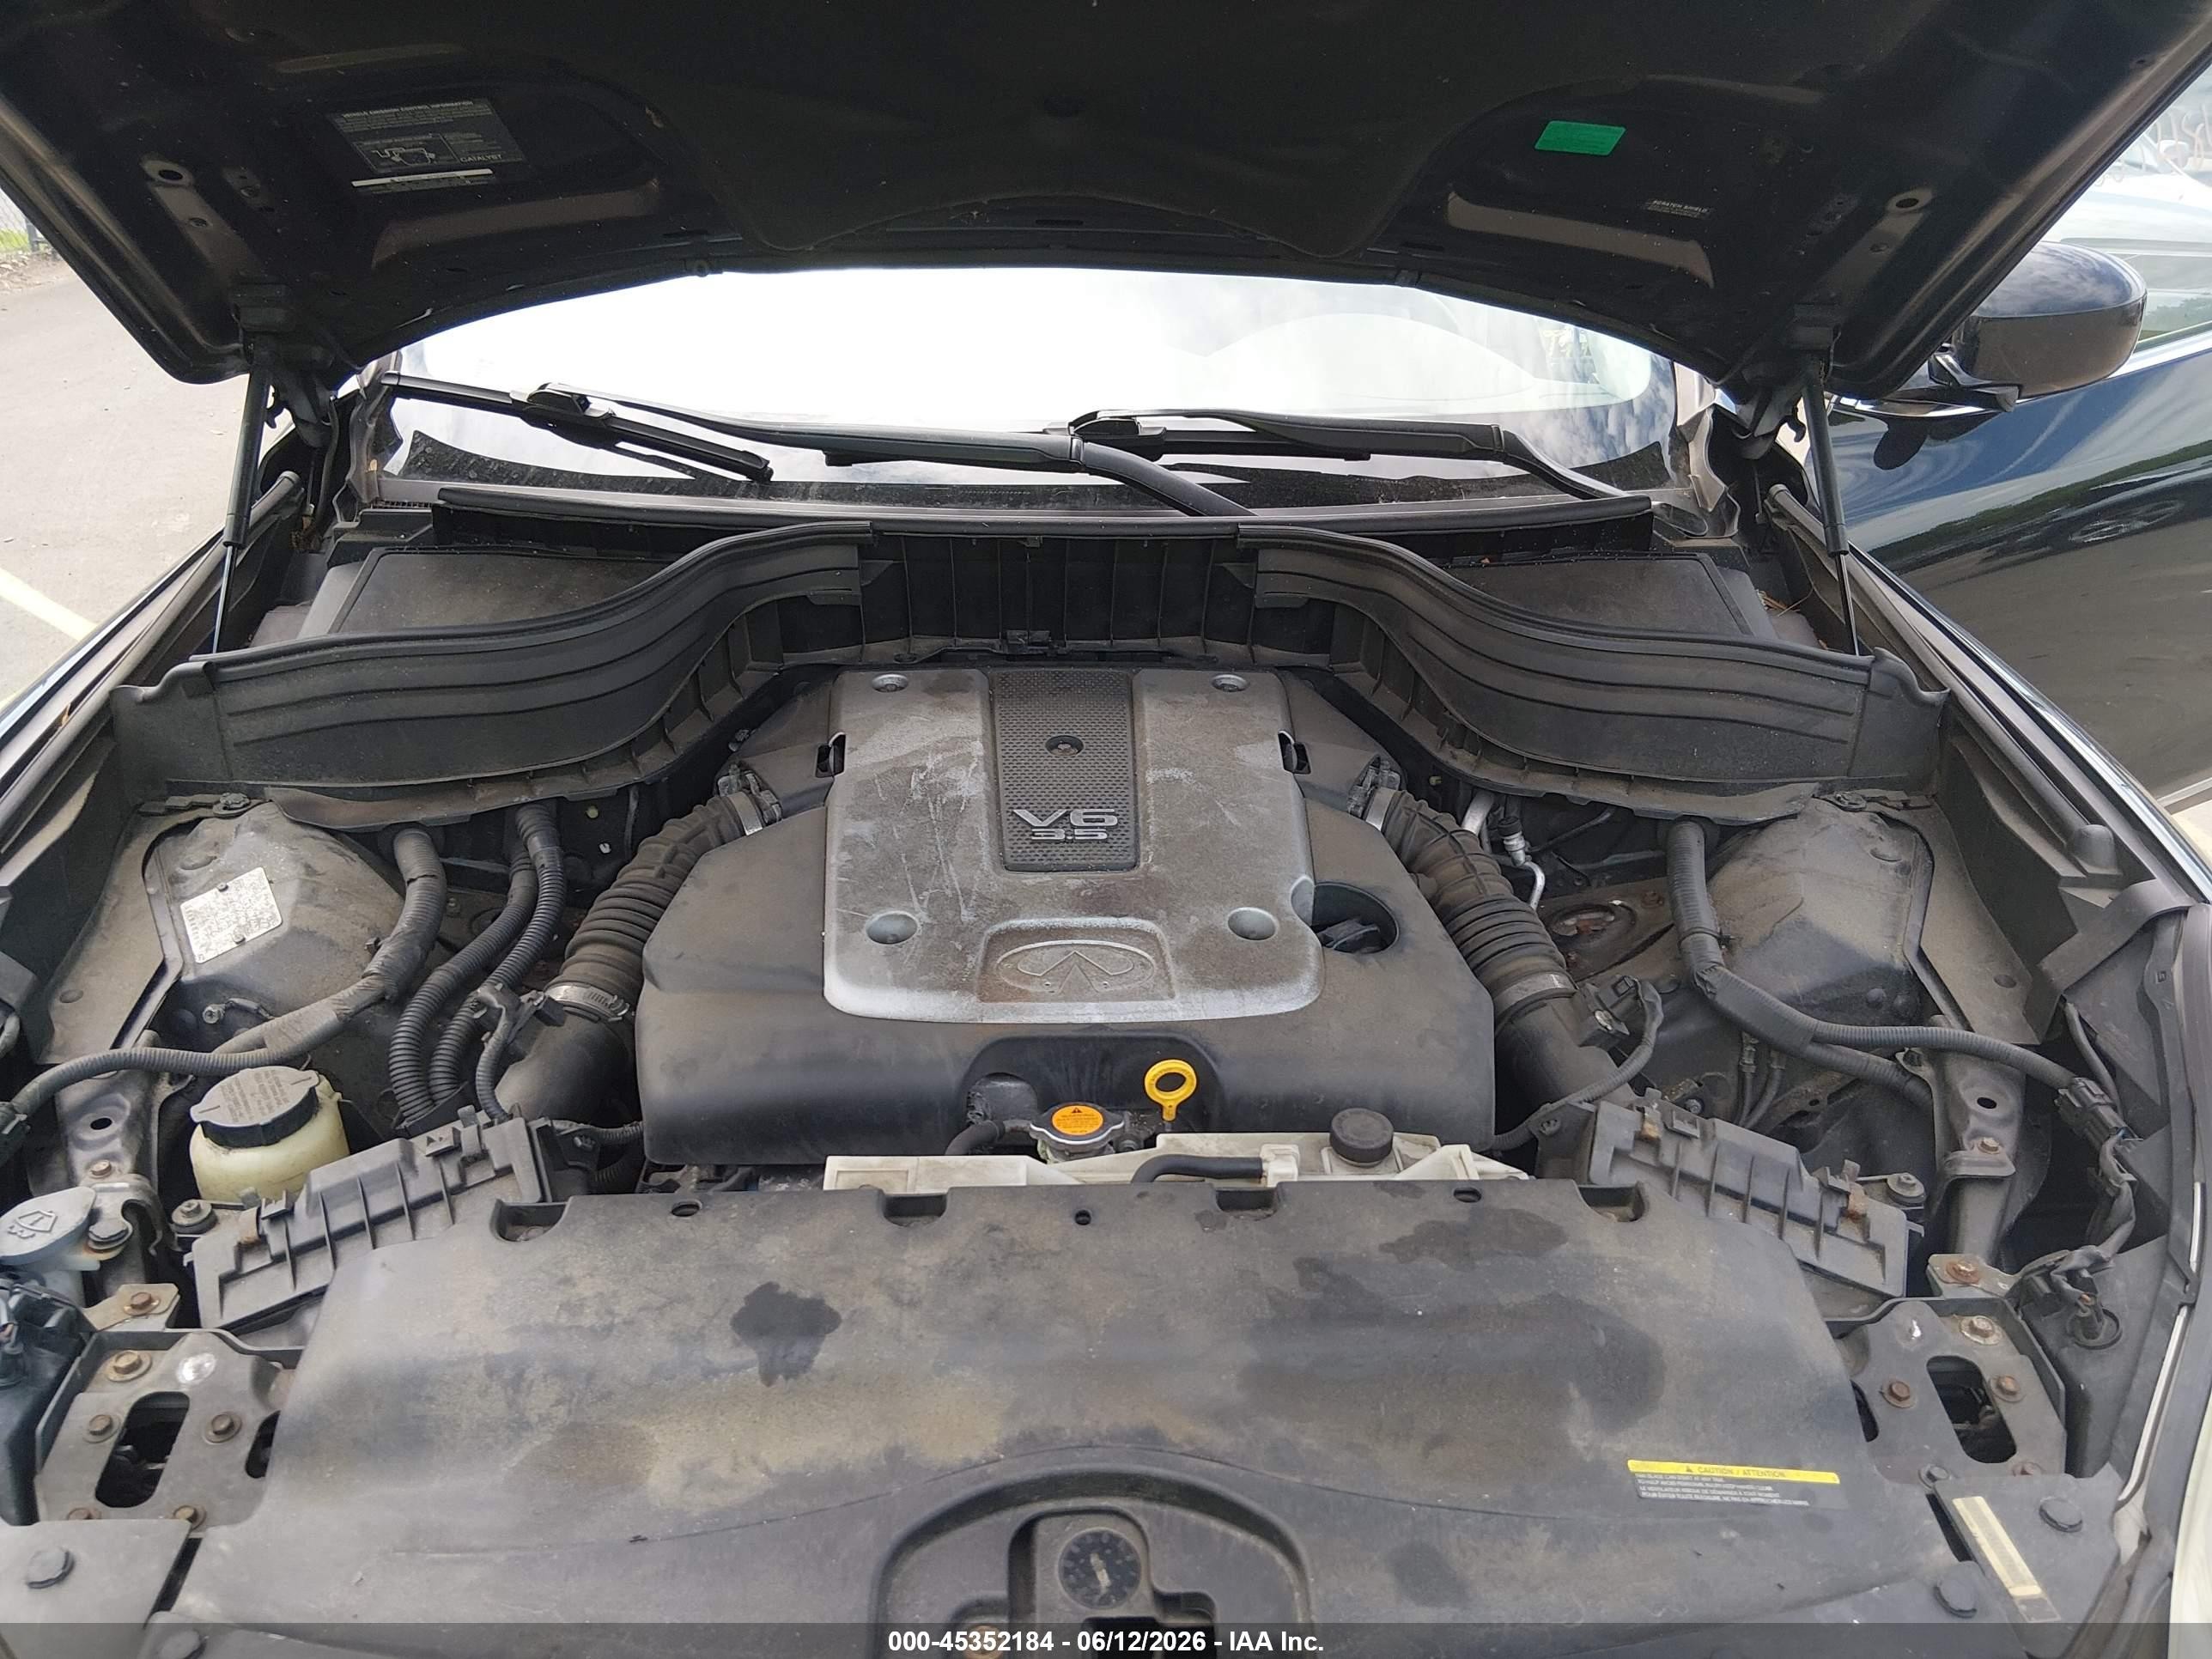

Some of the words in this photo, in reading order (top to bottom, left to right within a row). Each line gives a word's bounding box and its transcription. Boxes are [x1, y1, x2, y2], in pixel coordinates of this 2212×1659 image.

[460, 154, 502, 163] CATALYST
[1012, 809, 1118, 827] V6
[1031, 828, 1108, 840] 3.5
[1697, 1467, 1733, 1475] CAUTION
[1741, 1469, 1786, 1478] ATTENTION
